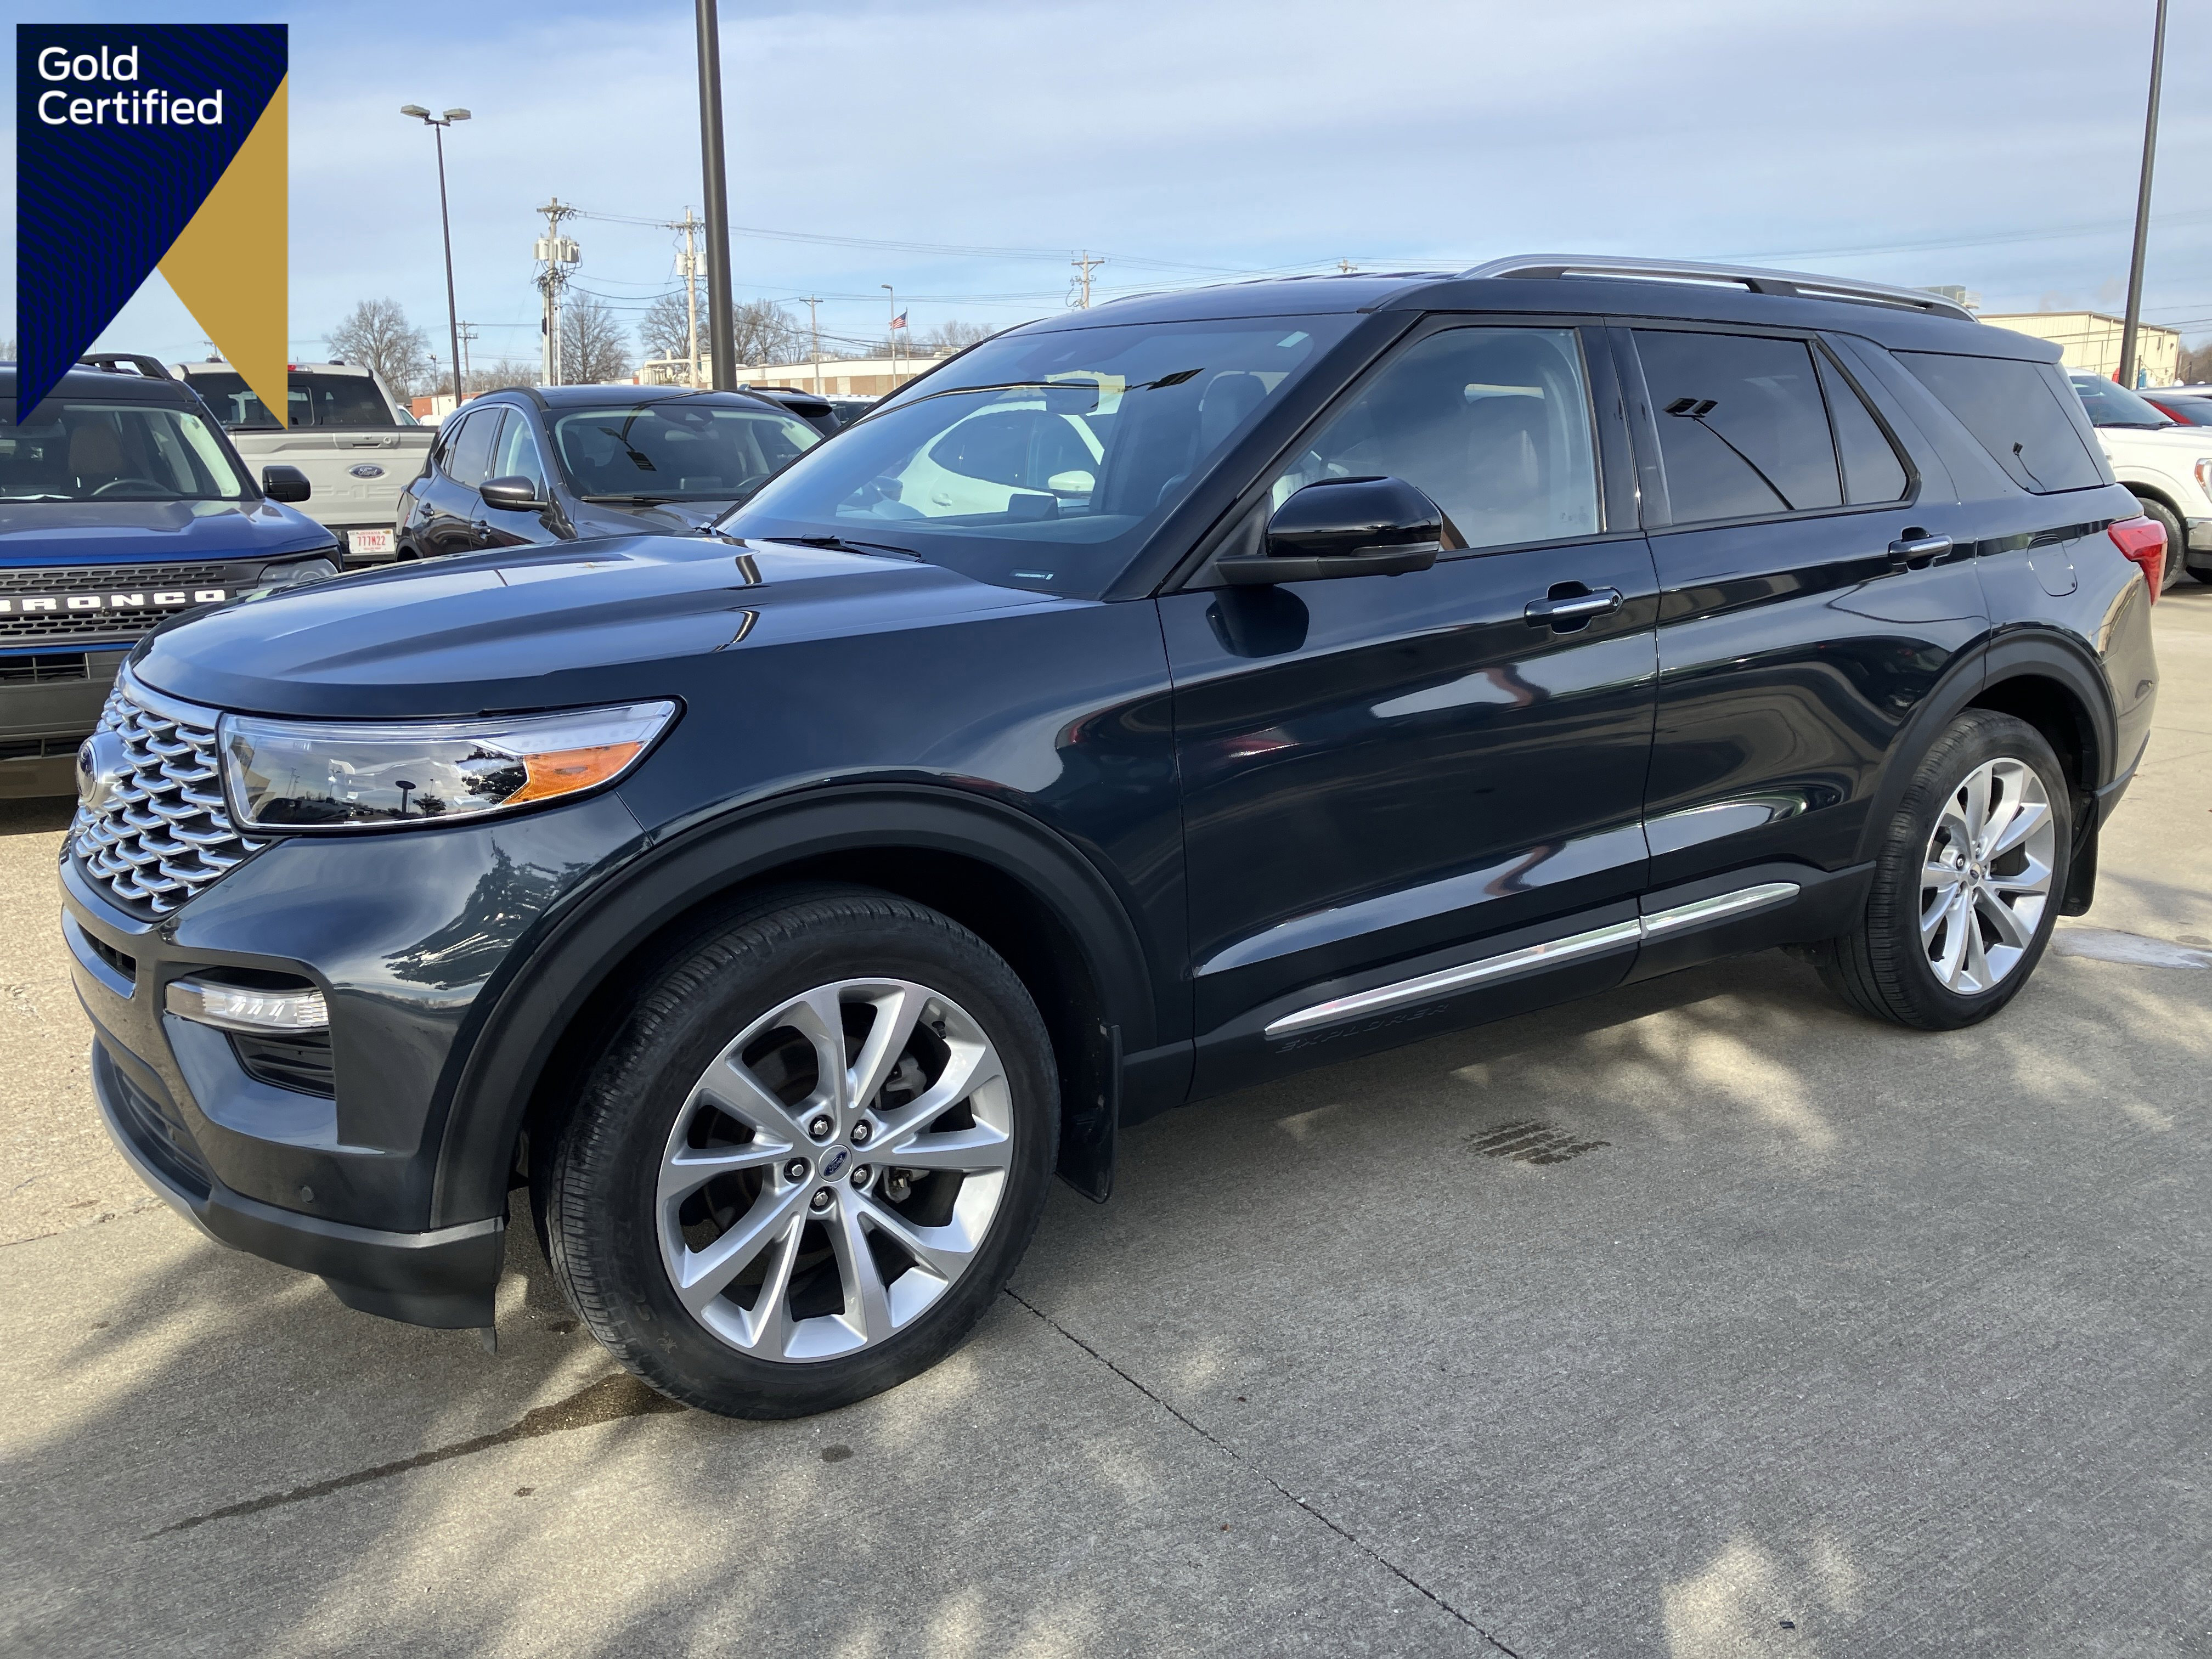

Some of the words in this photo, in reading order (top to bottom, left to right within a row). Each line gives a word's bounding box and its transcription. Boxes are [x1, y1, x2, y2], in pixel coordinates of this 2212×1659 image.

[358, 467, 377, 476] Ford
[1275, 1003, 1450, 1054] EXPLORER
[828, 1154, 843, 1173] Ford
